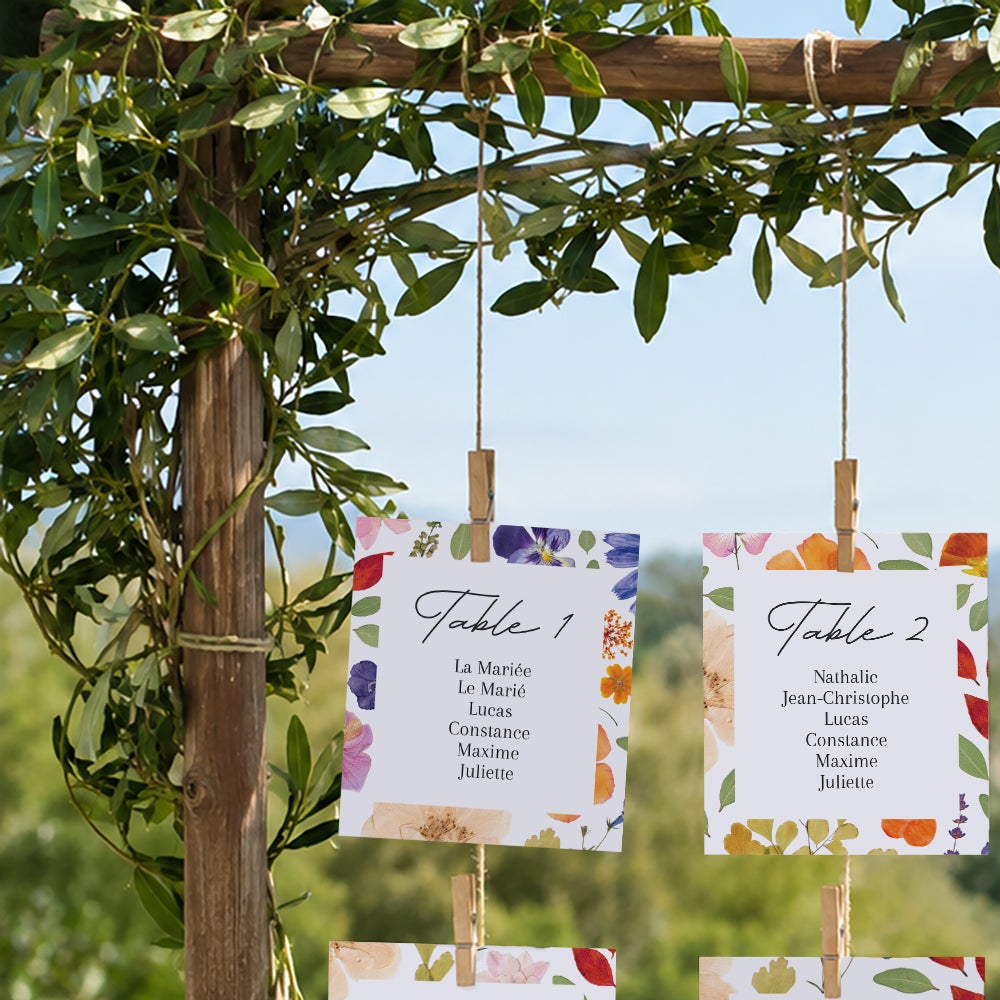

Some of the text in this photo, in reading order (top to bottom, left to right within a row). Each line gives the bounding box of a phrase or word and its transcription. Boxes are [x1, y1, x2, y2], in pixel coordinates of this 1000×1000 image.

[414, 588, 575, 644] Table 1
[767, 598, 929, 657] Table 2
[455, 658, 532, 678] La Mariée
[813, 669, 878, 684] Nathalie
[458, 679, 526, 699] Le Marié
[780, 690, 909, 709] Jean-Christophe
[469, 701, 513, 719] Lucas
[824, 711, 869, 726] Lucas
[448, 720, 530, 740] Constance
[805, 732, 888, 747] Constance
[457, 742, 520, 761] Maxime
[815, 753, 878, 768] Maxime
[457, 763, 514, 781] Juliette
[818, 774, 874, 792] Juliette
